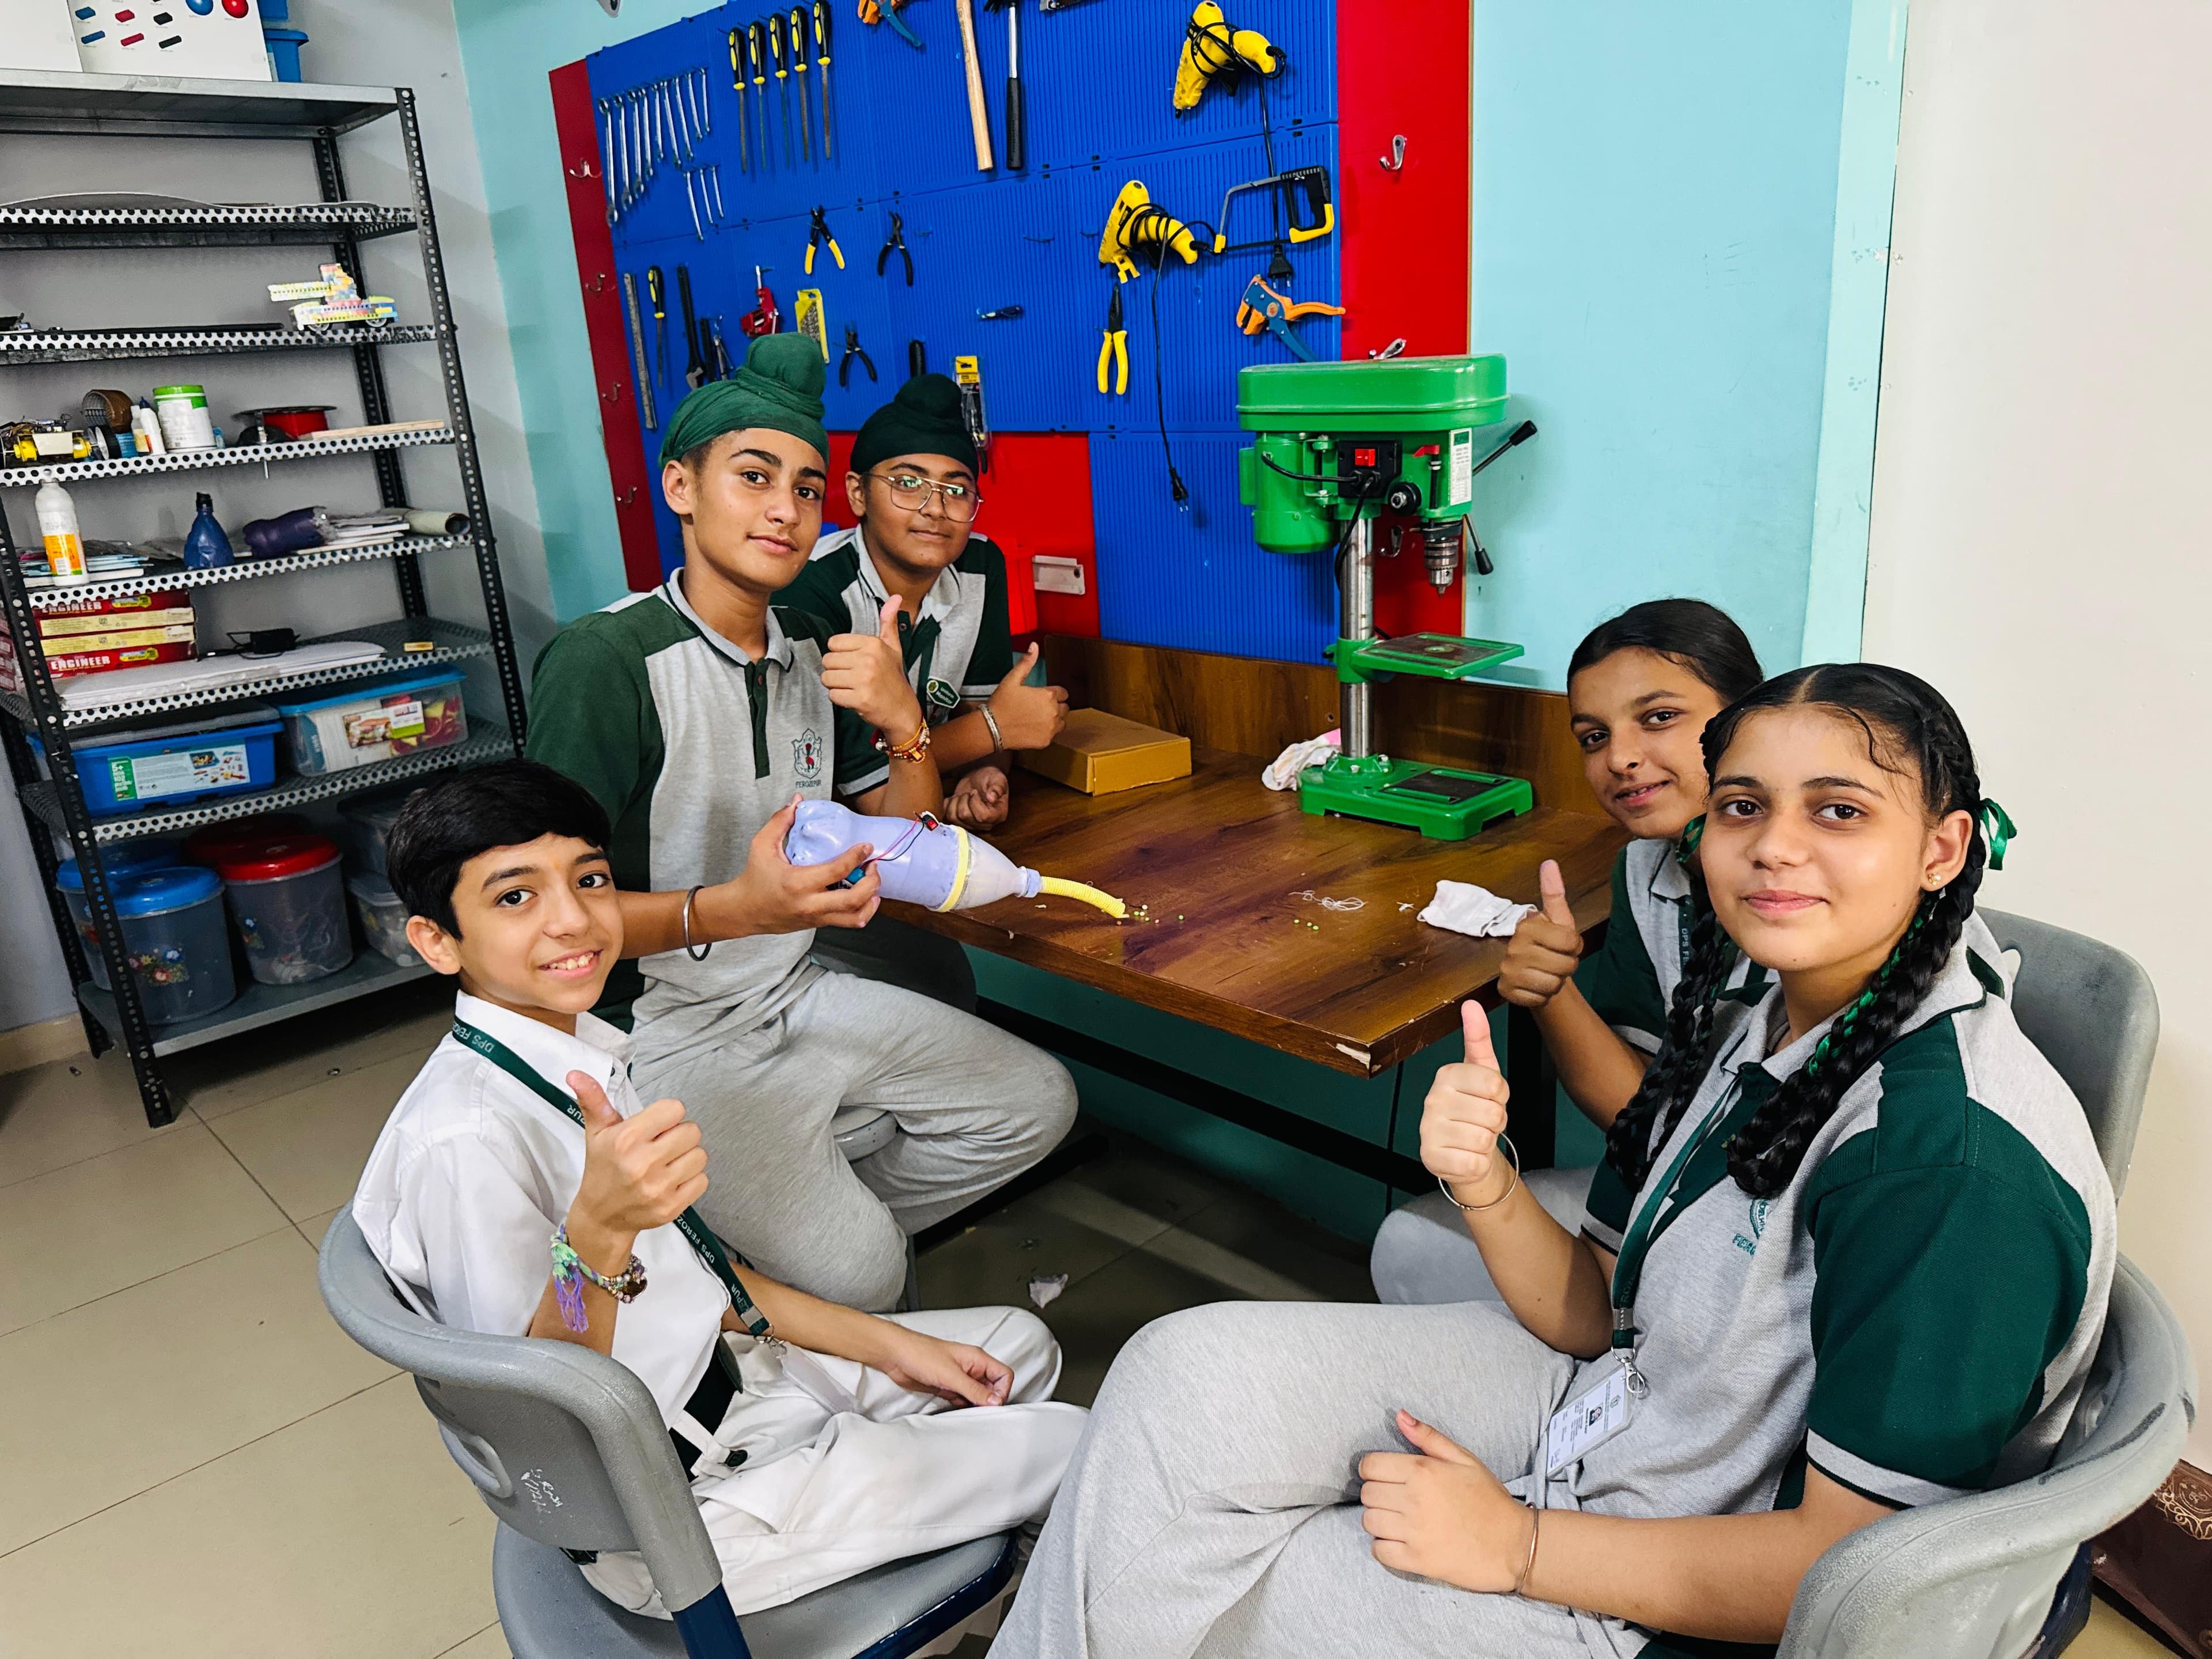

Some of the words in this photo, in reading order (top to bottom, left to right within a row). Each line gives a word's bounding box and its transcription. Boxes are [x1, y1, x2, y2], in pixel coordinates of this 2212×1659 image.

[50, 656, 110, 670] ENGINEER
[472, 1035, 495, 1053] DPS
[567, 1104, 585, 1124] PUR
[677, 1213, 701, 1245] FEROZ
[701, 1244, 715, 1263] DPS
